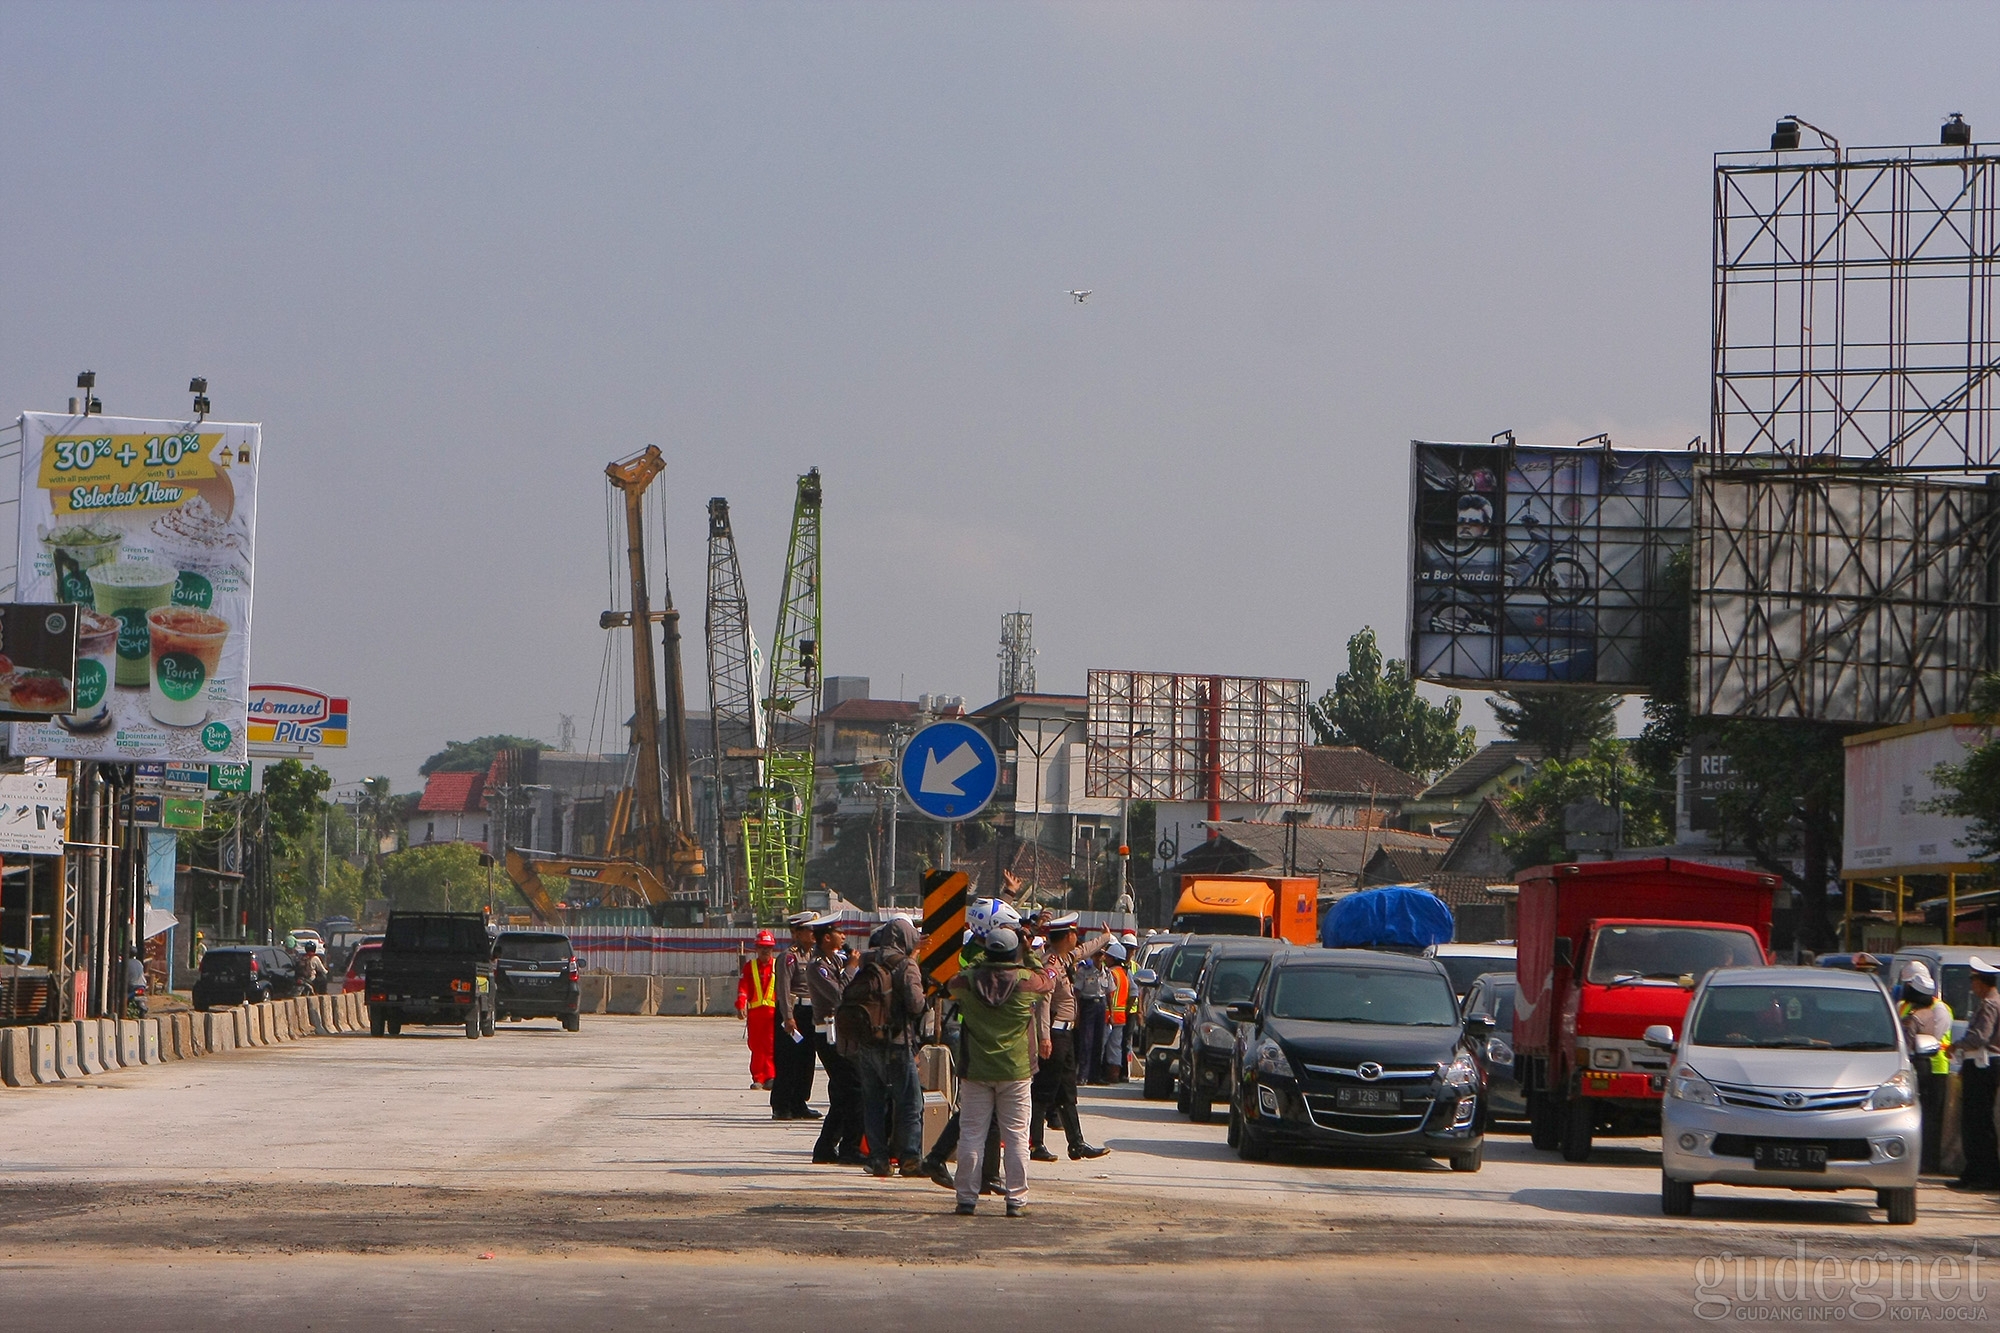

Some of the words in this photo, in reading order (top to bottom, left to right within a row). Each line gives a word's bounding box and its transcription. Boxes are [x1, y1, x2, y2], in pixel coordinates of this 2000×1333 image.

[54, 438, 112, 471] 30%
[115, 442, 138, 468] +
[144, 433, 200, 467] 10%
[78, 473, 111, 483] payment
[147, 470, 164, 478] with
[69, 482, 137, 510] Selected
[139, 480, 184, 505] Item
[163, 657, 200, 680] Point
[164, 677, 195, 694] Cafe
[247, 697, 323, 716] ndomaret
[37, 728, 65, 737] Periode
[207, 726, 228, 740] Point
[273, 721, 324, 743] Plus
[167, 771, 192, 781] ATM
[217, 777, 243, 790] Cafe
[570, 867, 598, 877] SANY
[1357, 1090, 1380, 1102] 1269
